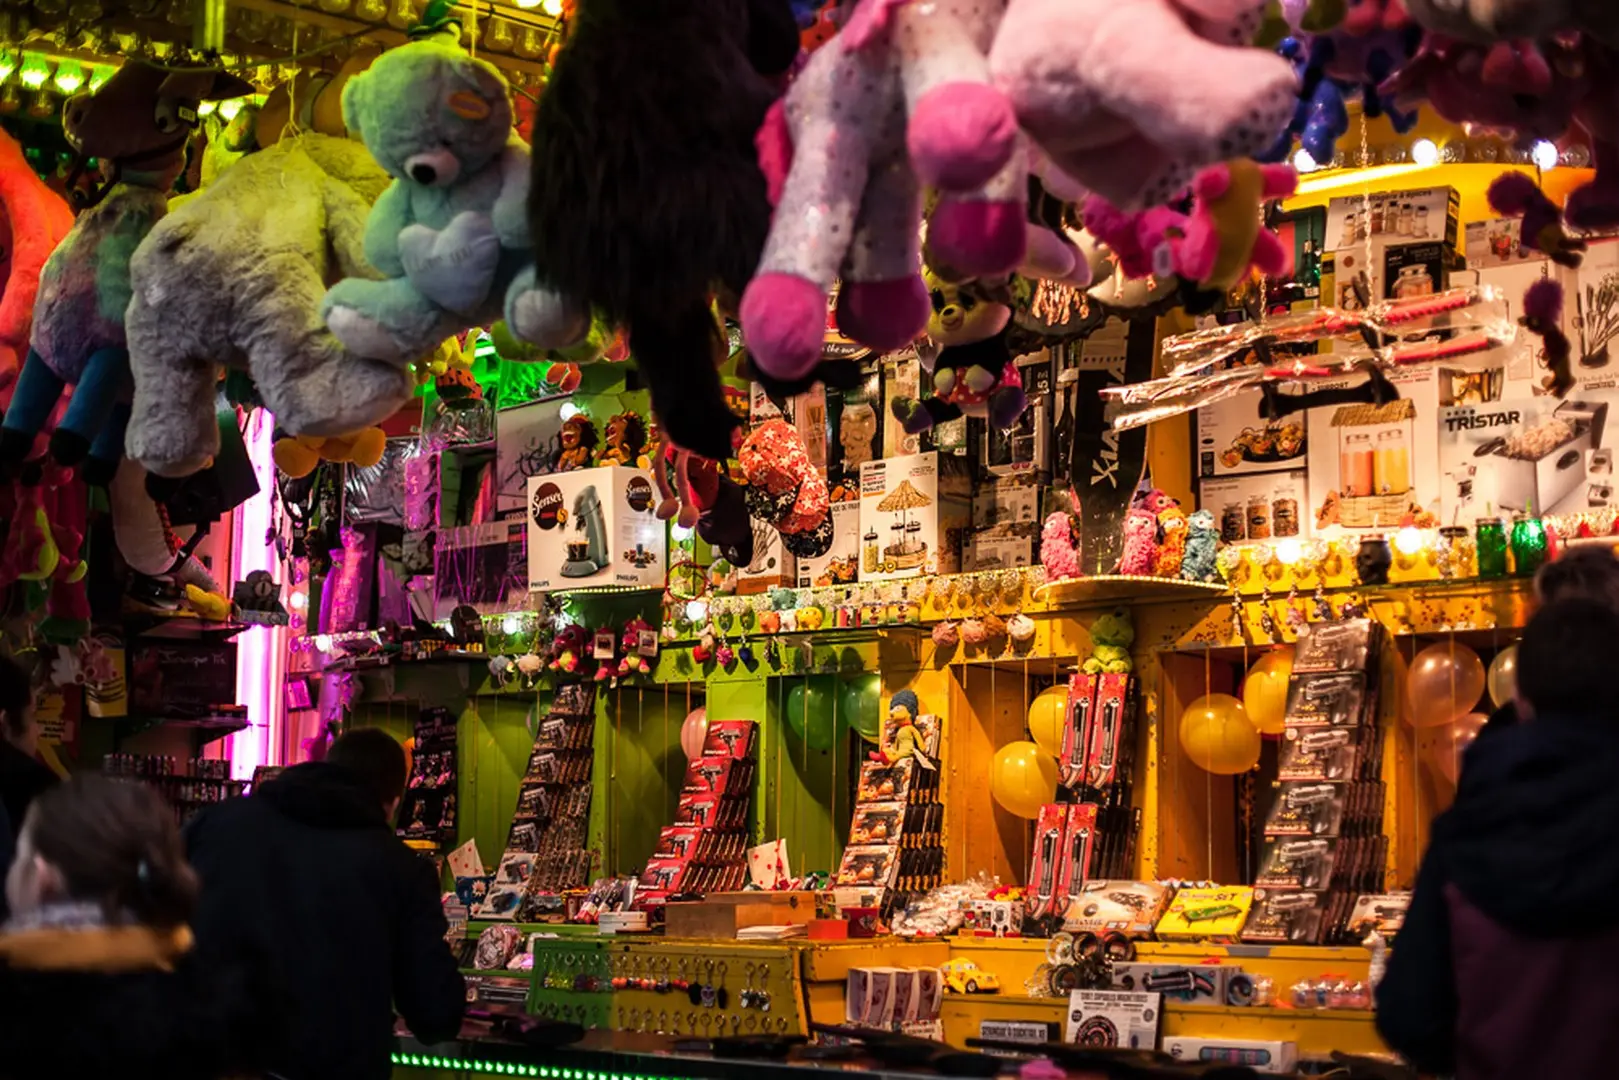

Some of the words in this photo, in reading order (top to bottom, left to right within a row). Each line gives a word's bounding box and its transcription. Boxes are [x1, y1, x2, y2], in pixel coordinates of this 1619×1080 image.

[1446, 410, 1521, 432] TRISTAR
[616, 574, 639, 582] PHILIPS
[530, 580, 550, 588] PHILIPS
